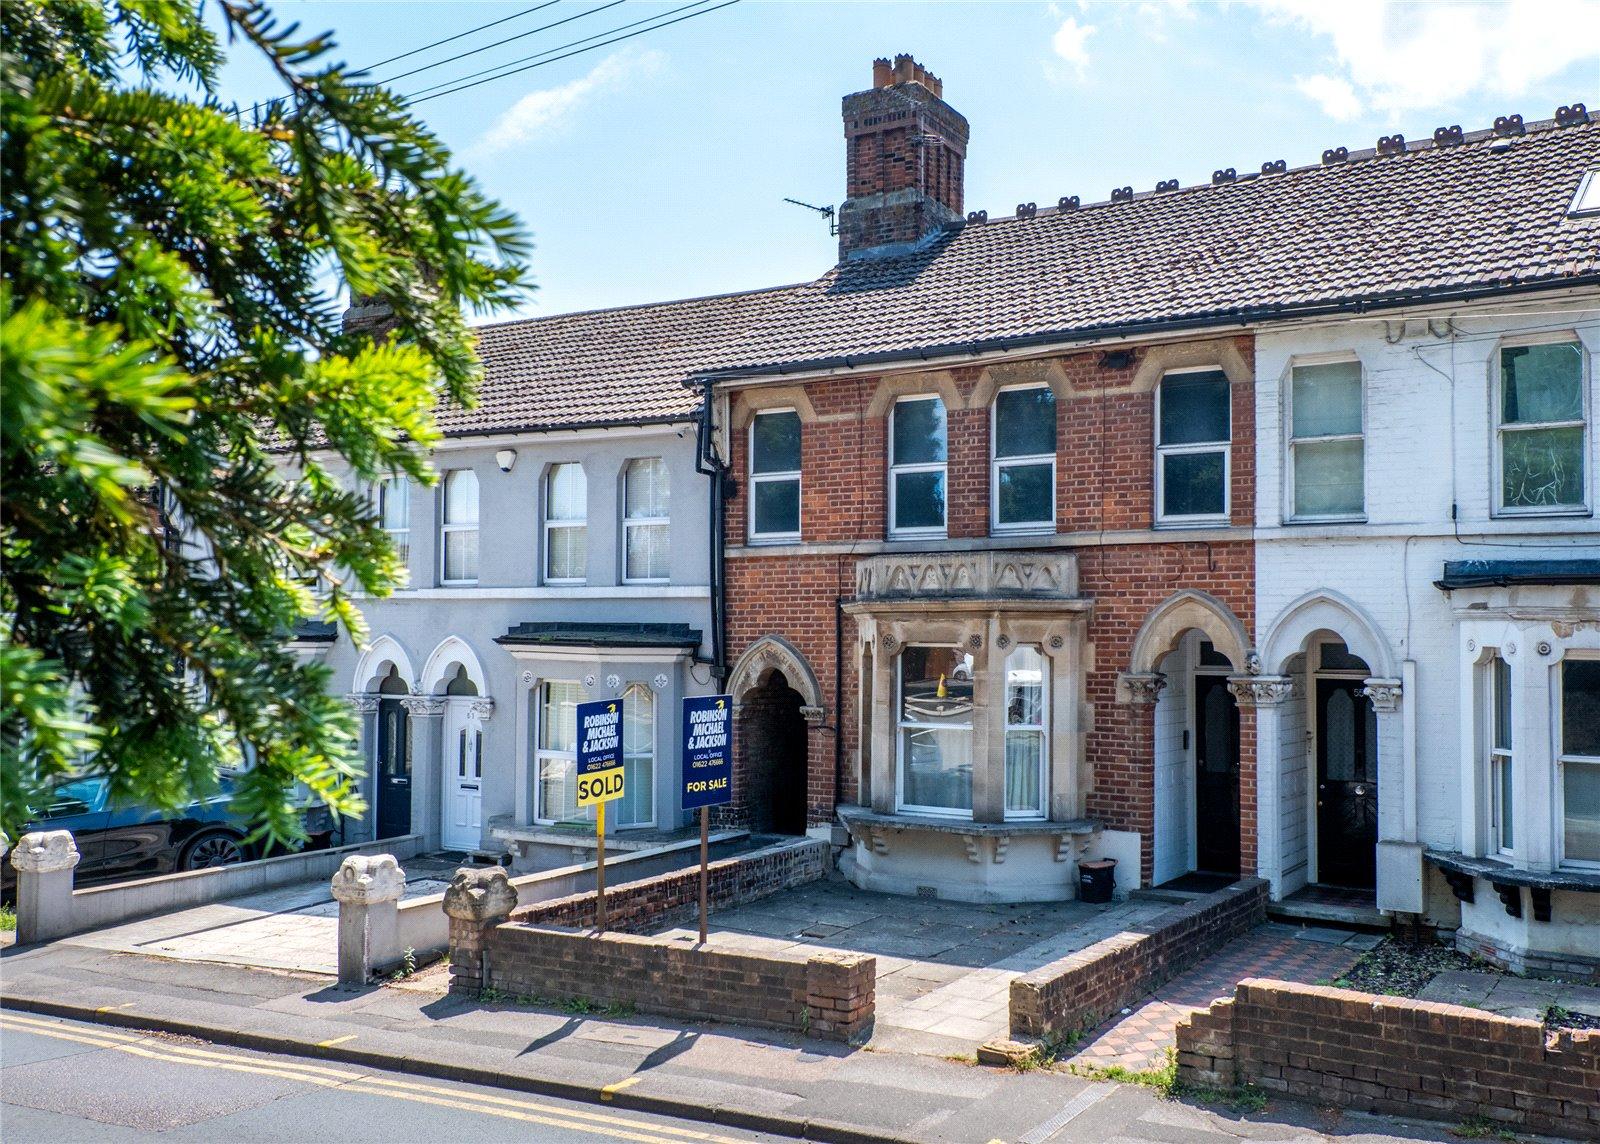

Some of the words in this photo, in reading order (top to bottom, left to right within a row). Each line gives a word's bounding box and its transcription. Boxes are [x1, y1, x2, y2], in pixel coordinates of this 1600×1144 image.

[584, 712, 619, 728] ROBINSON
[690, 709, 727, 724] ROBINSON
[587, 725, 616, 740] MICHAEL
[693, 721, 724, 736] MICHAEL
[582, 740, 589, 753] &
[589, 736, 619, 752] JACKSON
[688, 736, 694, 749] &
[695, 733, 727, 749] JACKSON
[578, 773, 623, 800] SOLD
[687, 781, 706, 792] FOR
[708, 777, 727, 789] SALE
